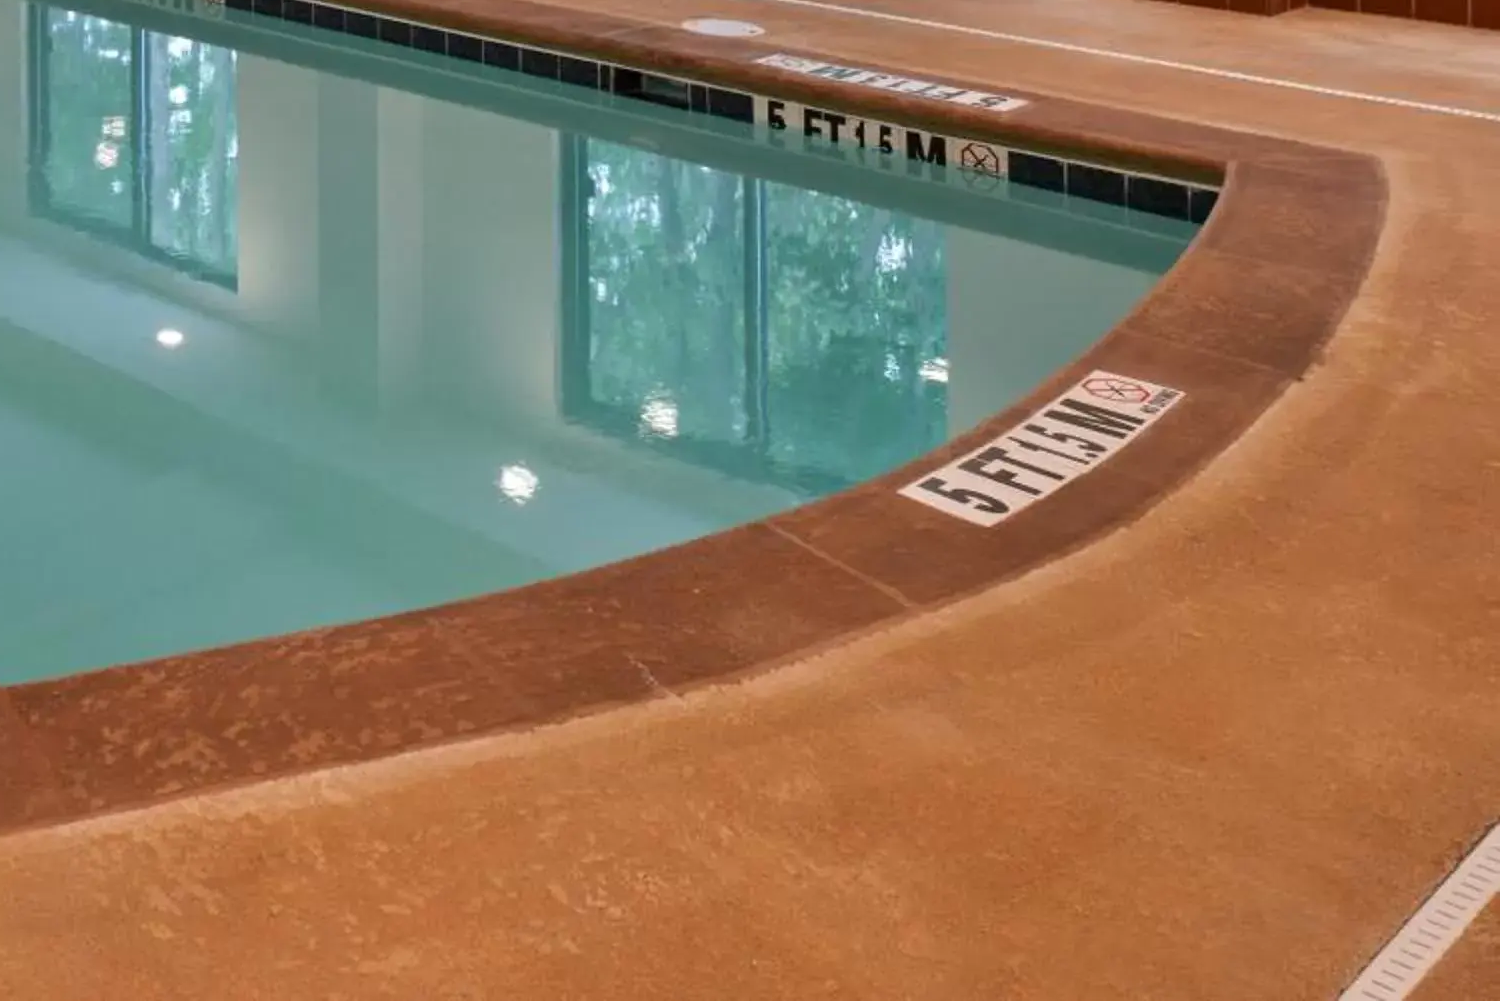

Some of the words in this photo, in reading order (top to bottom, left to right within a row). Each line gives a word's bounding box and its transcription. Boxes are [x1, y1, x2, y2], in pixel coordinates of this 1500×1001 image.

[767, 100, 787, 130] 5
[803, 107, 847, 143] FT
[906, 131, 947, 166] M
[1043, 397, 1146, 440] M
[1006, 423, 1108, 466] 1.5
[957, 446, 1066, 497] FT
[916, 477, 1010, 515] 5
